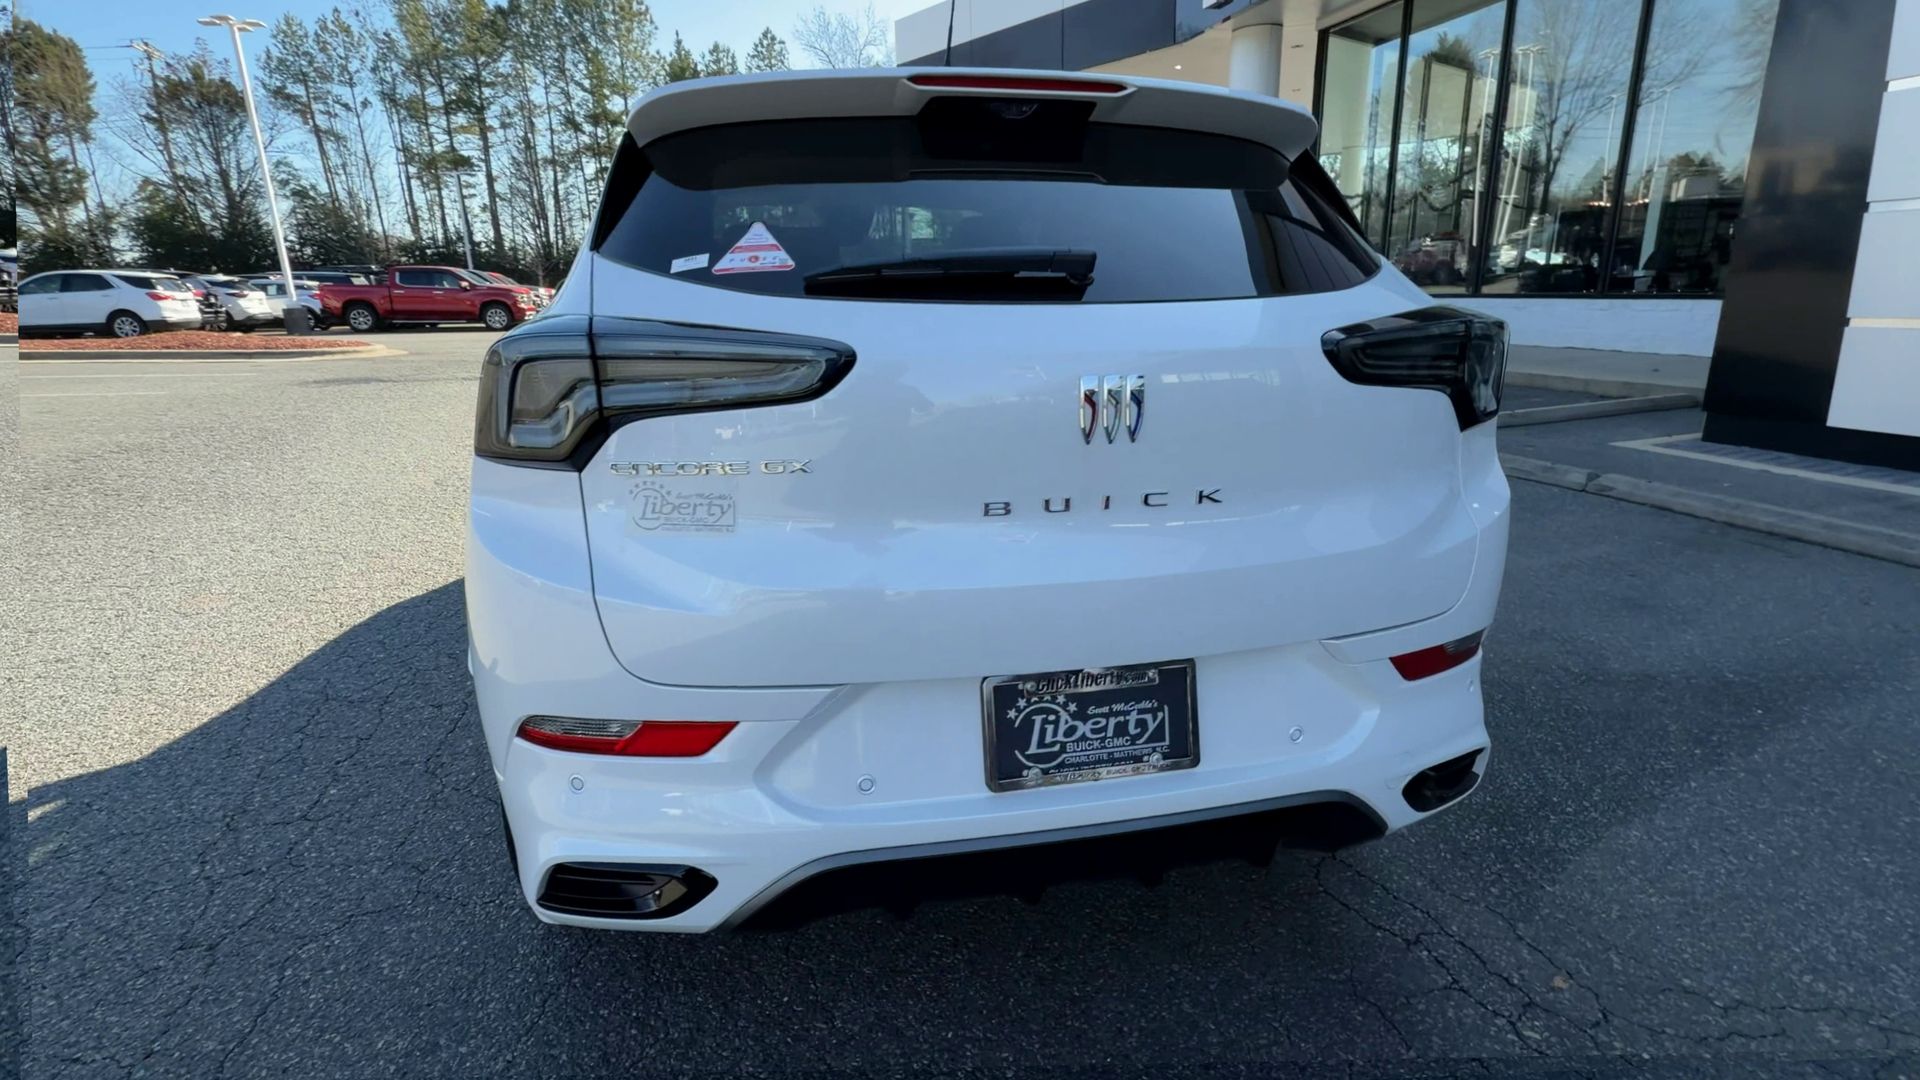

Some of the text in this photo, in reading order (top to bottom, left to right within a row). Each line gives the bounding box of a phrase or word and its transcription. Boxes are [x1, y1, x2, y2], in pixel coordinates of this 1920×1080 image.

[610, 459, 813, 476] ENCORE GX
[639, 495, 732, 523] Liberty
[983, 488, 1222, 517] BUICK
[1025, 709, 1164, 755] Liberty
[1066, 736, 1132, 752] BUICK-GMC
[1064, 754, 1108, 765] CHARLOTTE
